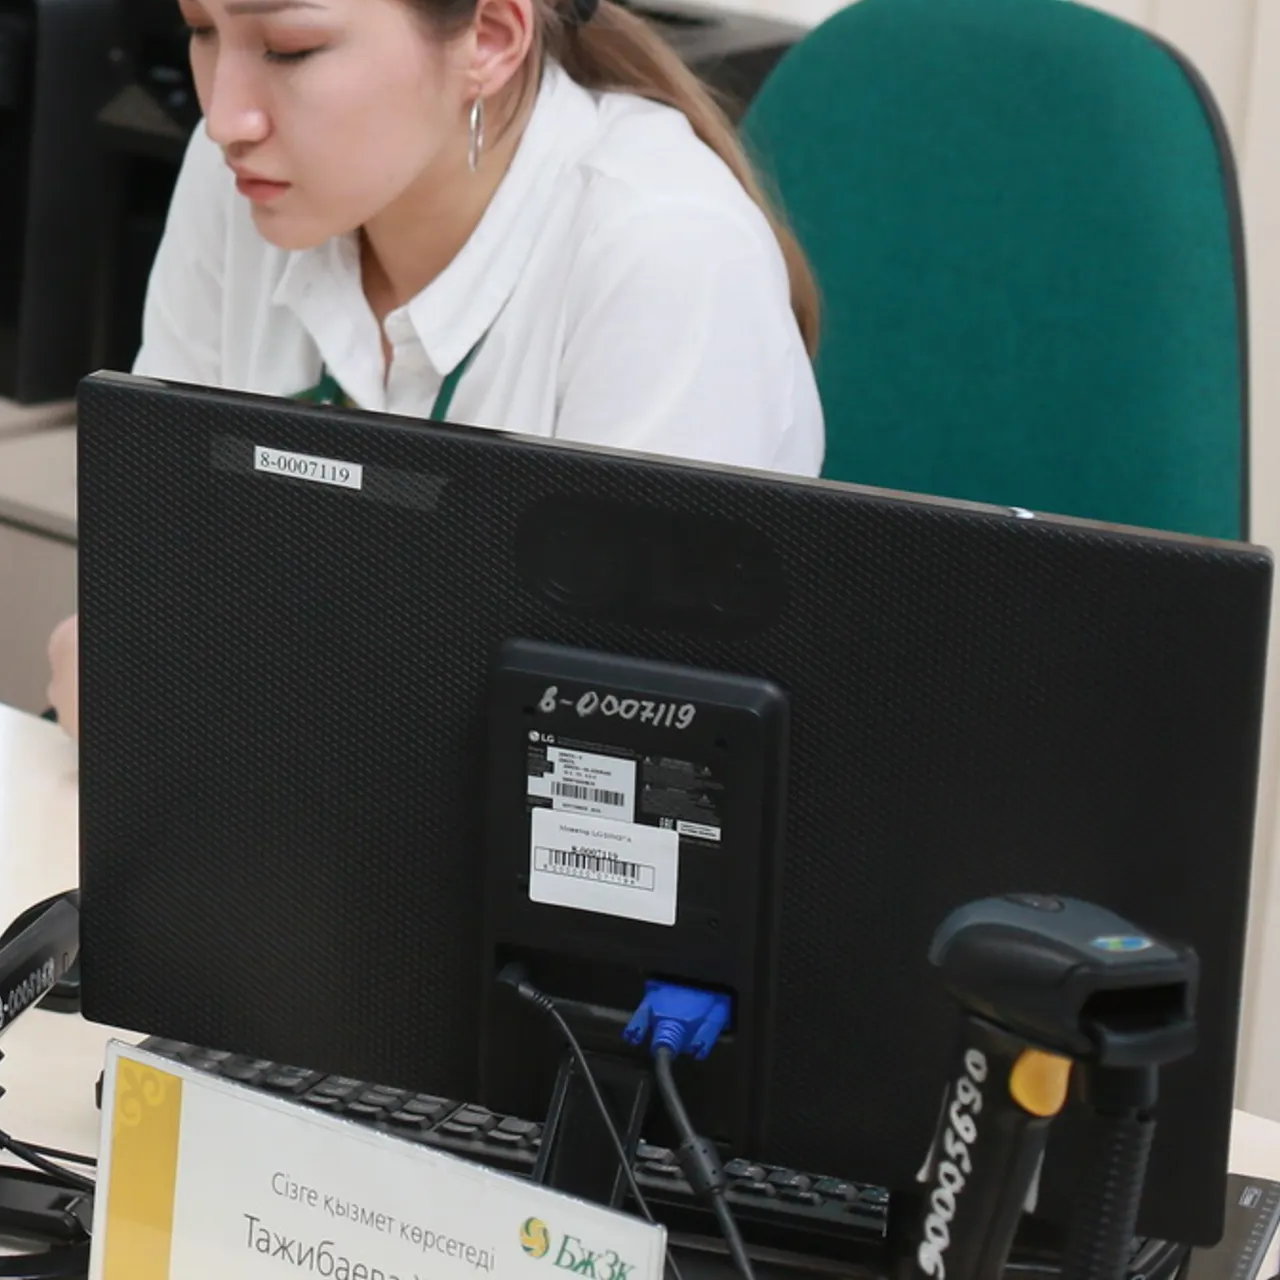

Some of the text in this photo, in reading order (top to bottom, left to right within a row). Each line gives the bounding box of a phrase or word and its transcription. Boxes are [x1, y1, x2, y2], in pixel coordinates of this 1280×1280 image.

[260, 452, 350, 483] 8-0007119
[541, 733, 555, 743] LG
[271, 1171, 495, 1273] Сізге қызмет көрсетеді
